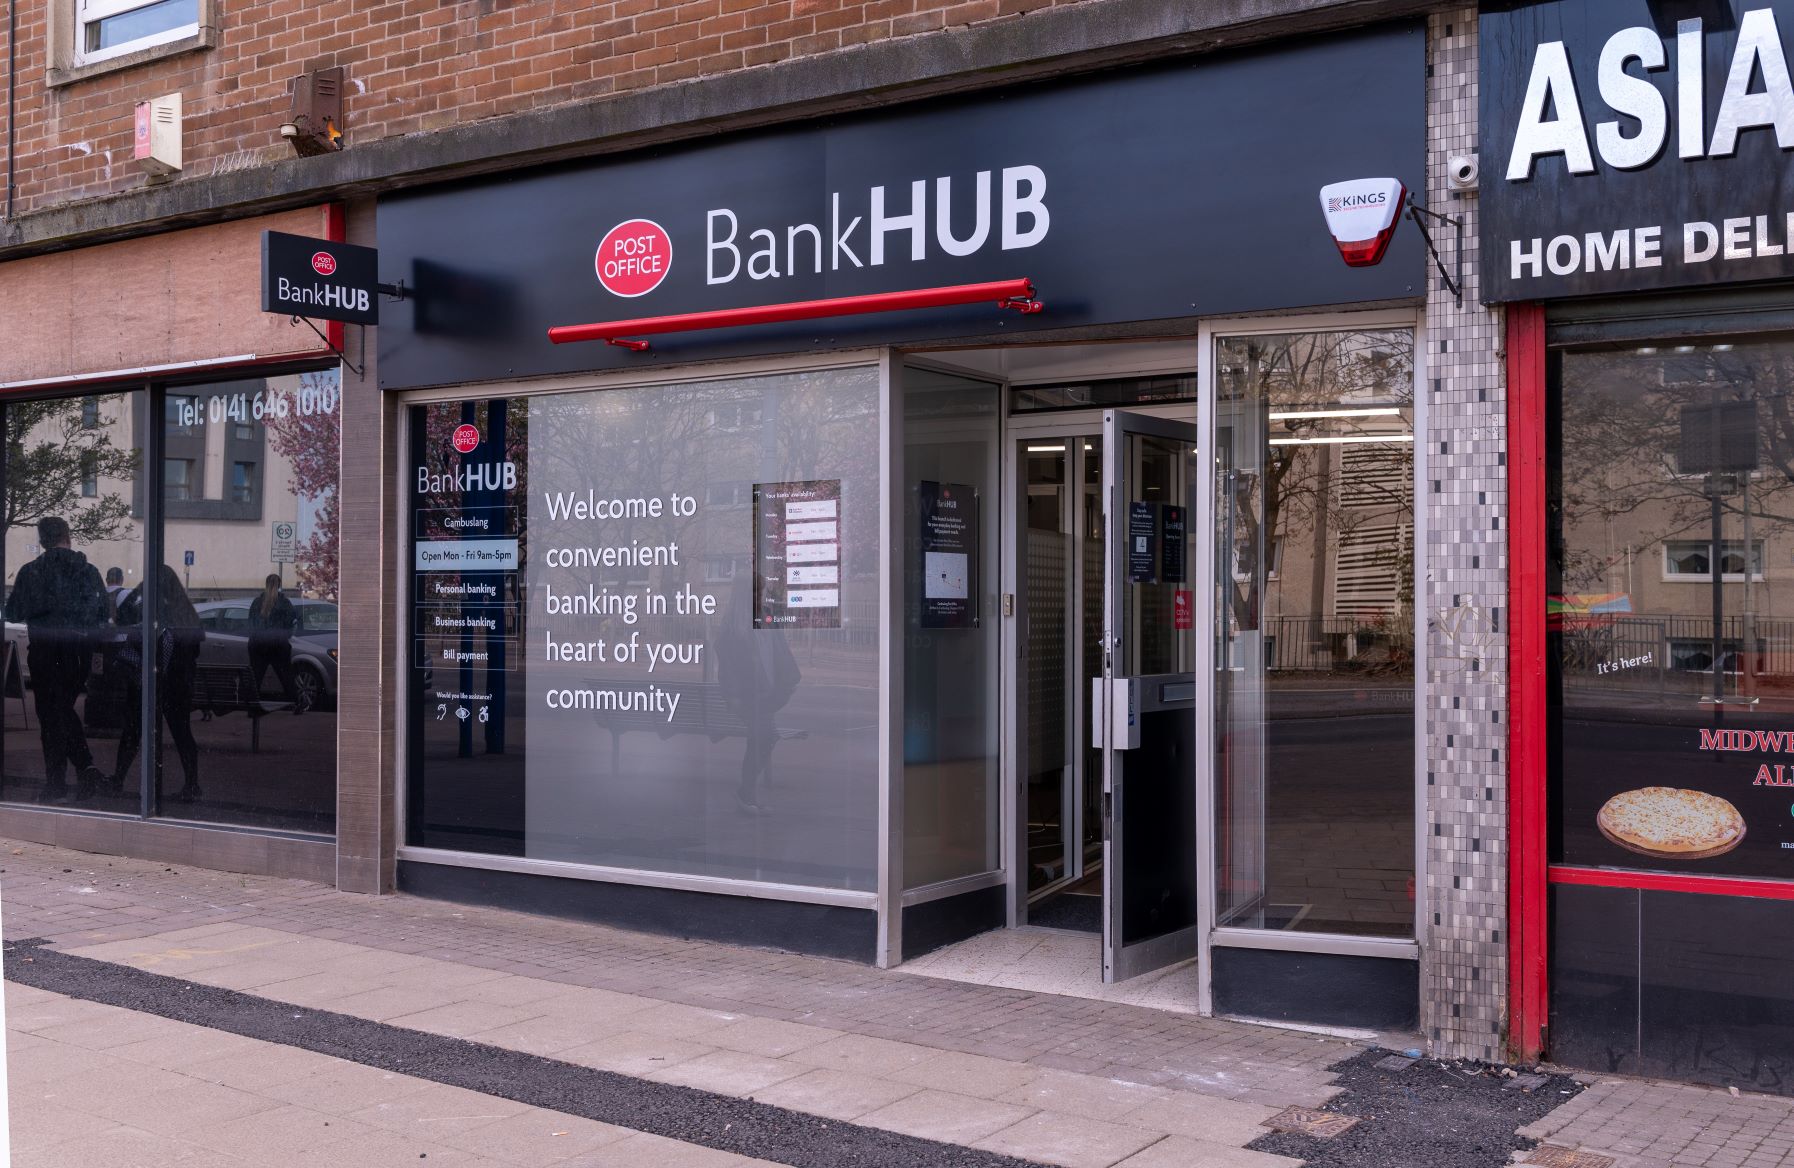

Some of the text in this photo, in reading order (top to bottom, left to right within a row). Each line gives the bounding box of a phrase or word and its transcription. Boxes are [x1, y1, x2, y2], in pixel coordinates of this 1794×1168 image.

[1505, 8, 1794, 181] ASIA
[706, 164, 1050, 286] BankHUB
[614, 234, 656, 256] POST
[1510, 225, 1662, 280] HOME
[314, 262, 333, 270] OFFICE
[317, 256, 331, 264] POST
[604, 255, 661, 279] OFFICE
[279, 277, 370, 311] BankHUB
[176, 384, 335, 427] Tel: 0141 646 1010
[456, 437, 476, 446] OFFICE
[418, 462, 517, 493] BankHUB
[545, 488, 697, 521] Welcome to
[444, 516, 489, 529] Cambuslang
[422, 551, 442, 563] Open
[443, 551, 459, 560] Mon
[466, 551, 476, 560] Fri
[477, 550, 512, 562] 9am-5pm
[546, 539, 679, 568] convenient
[435, 583, 496, 597] Personal banking
[546, 583, 716, 625] banking in the
[435, 616, 496, 630] Business banking
[443, 649, 488, 663] Bill payment
[546, 631, 704, 673] heart of your
[1619, 651, 1652, 669] here!
[546, 684, 681, 722] community
